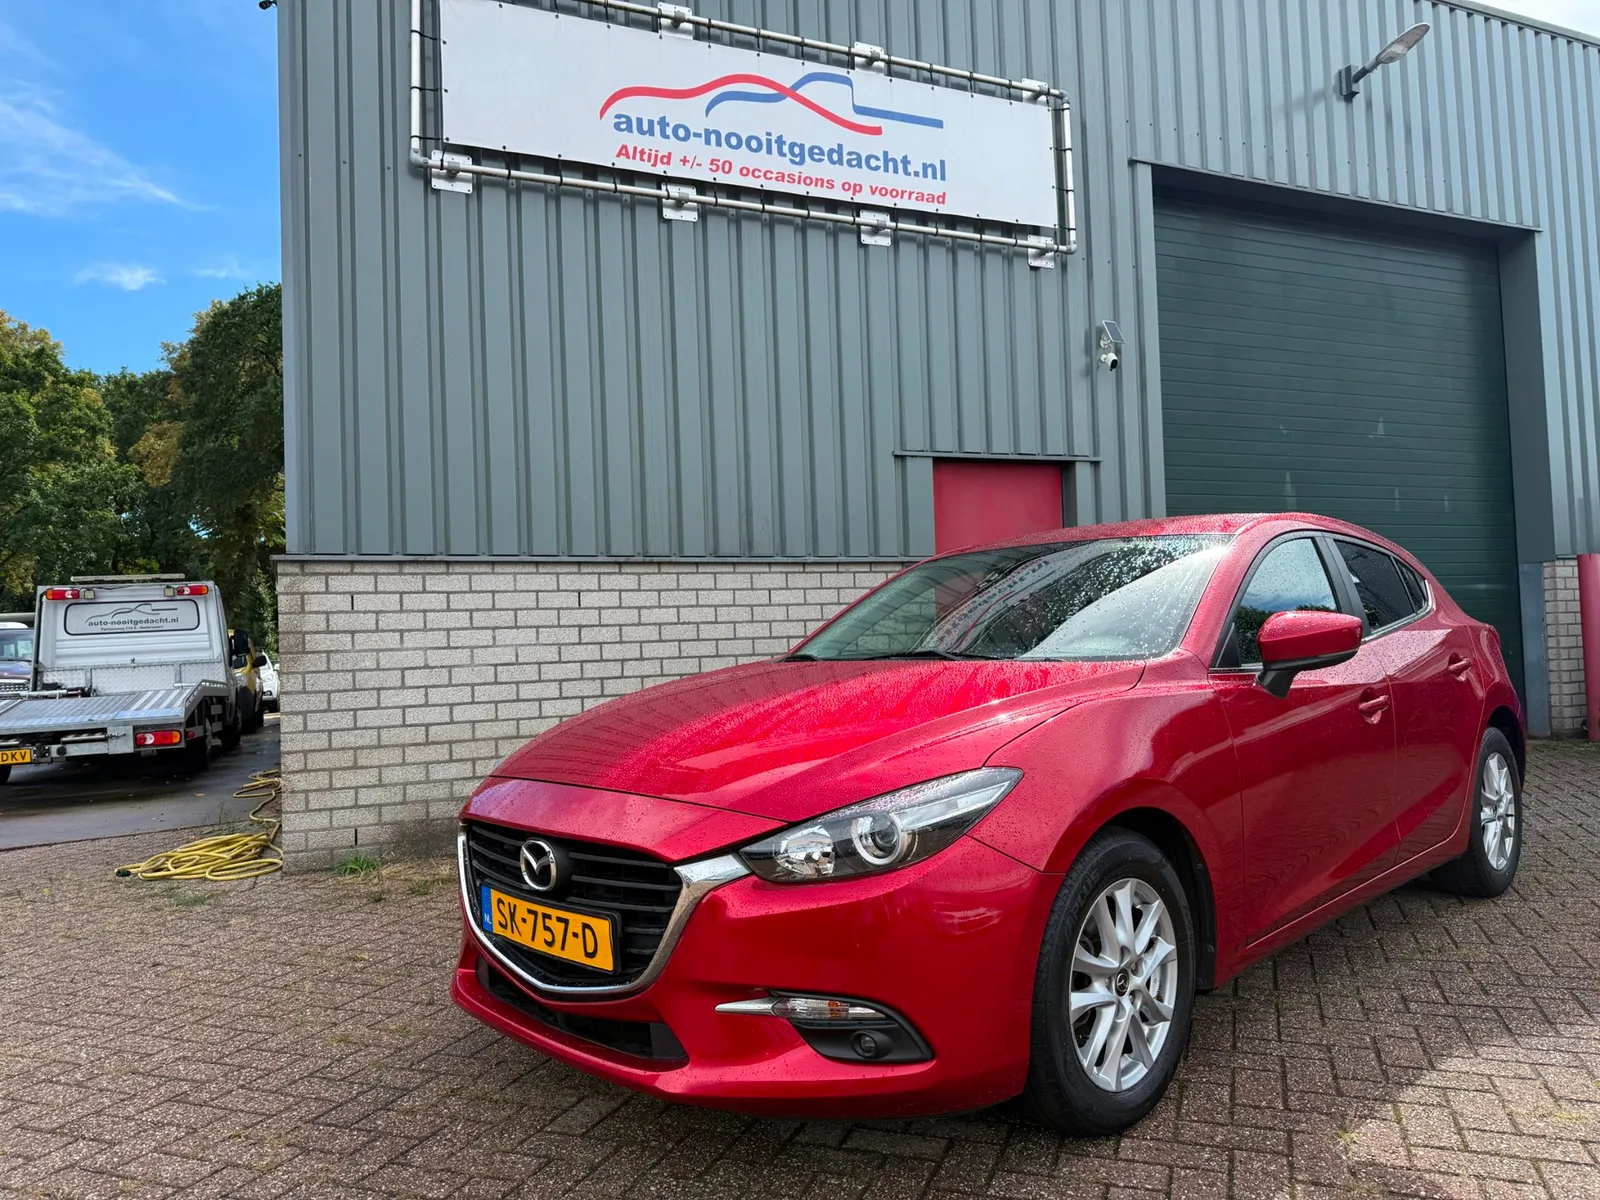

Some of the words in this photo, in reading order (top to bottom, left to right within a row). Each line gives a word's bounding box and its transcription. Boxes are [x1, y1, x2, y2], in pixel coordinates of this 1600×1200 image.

[612, 112, 947, 182] auto-nooitgedacht.nl
[615, 143, 672, 167] Altijd
[679, 154, 702, 169] +/-
[708, 158, 733, 175] 50
[738, 165, 835, 190] occasions
[841, 180, 863, 196] op
[869, 184, 947, 206] voorraad
[88, 617, 179, 627] auto-nooitgedacht.nl
[497, 897, 598, 957] SK-757-D
